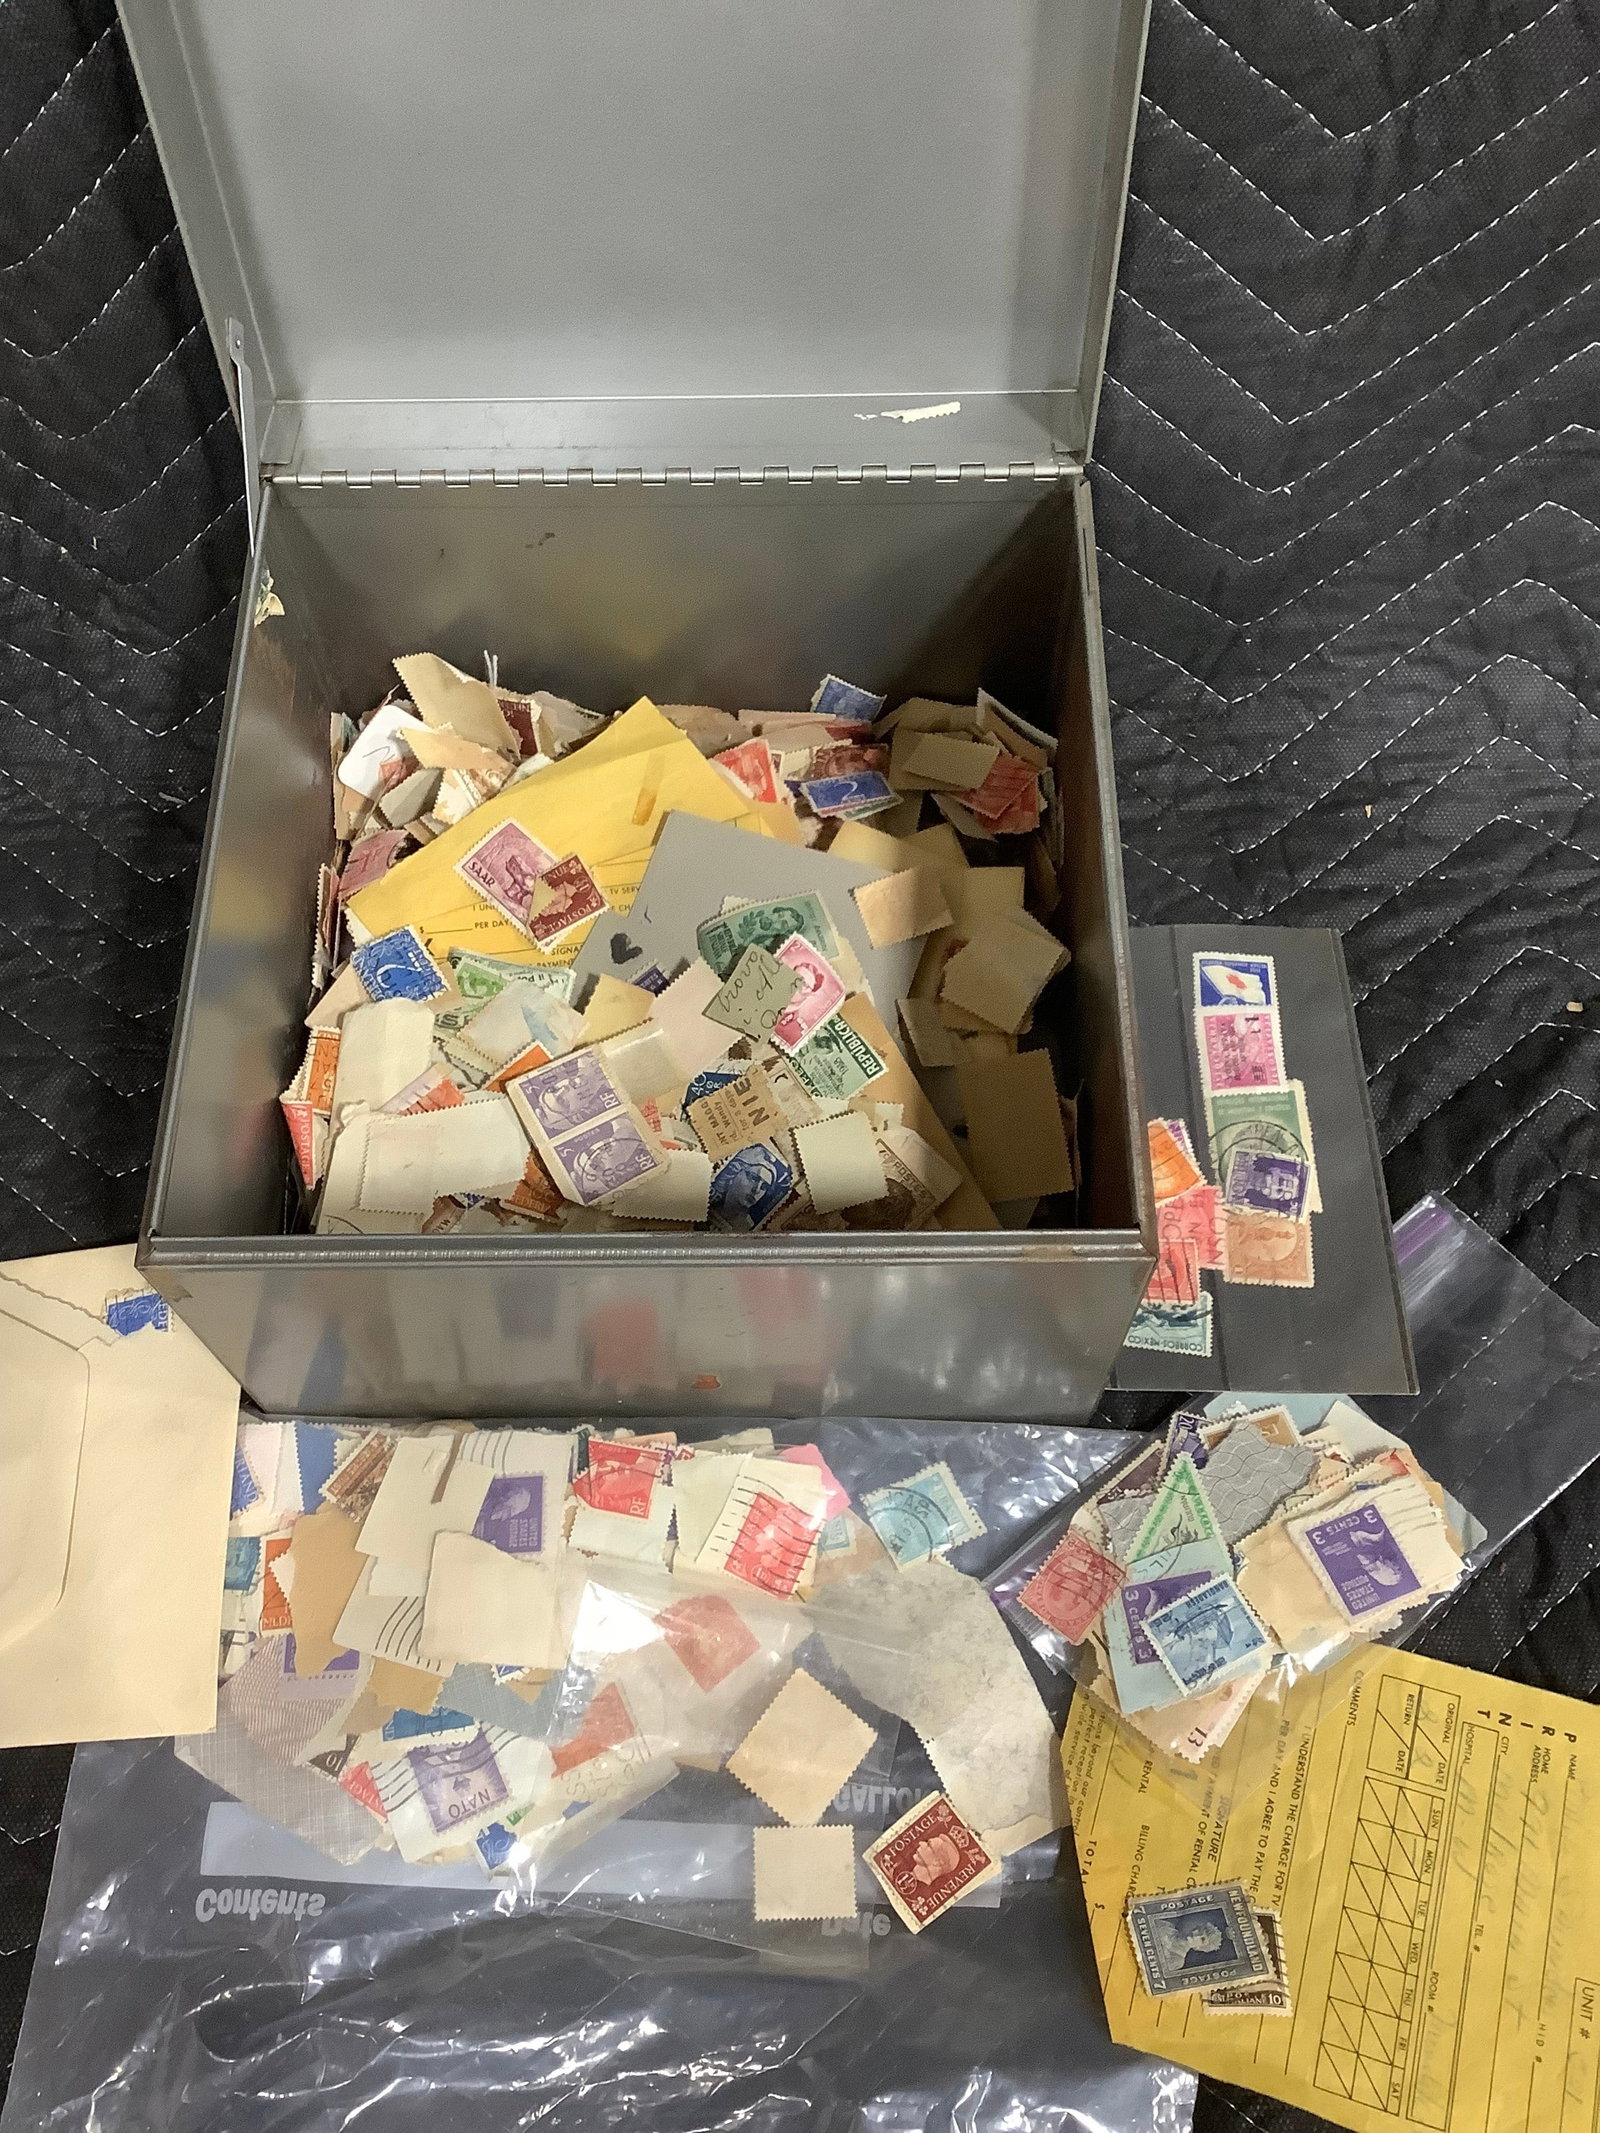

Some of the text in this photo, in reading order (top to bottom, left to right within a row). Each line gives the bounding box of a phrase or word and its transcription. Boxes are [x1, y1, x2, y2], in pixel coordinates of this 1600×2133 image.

[469, 861, 496, 889] SAAR
[475, 921, 490, 930] PER
[492, 919, 510, 928] DAY
[600, 1085, 619, 1109] RF
[300, 1118, 310, 1172] POSTAGE
[635, 1154, 655, 1171] RF
[630, 1496, 647, 1516] RF
[519, 1518, 529, 1547] STATES
[528, 1518, 538, 1547] UNITED
[1312, 1509, 1378, 1545] 3 CENTS 3
[1186, 1580, 1230, 1609] BANGLADESH
[1346, 1583, 1375, 1601] STATES
[1351, 1593, 1380, 1610] UNITED
[1125, 1589, 1153, 1661] 3 CENTS 3
[1346, 1670, 1364, 1727] COMMENTS
[1187, 1726, 1208, 1748] 13
[1281, 1719, 1291, 1738] PER
[1395, 1693, 1415, 1773] RETURN DATE
[1435, 1702, 1456, 1785] ORIGINAL DATE
[1463, 1724, 1475, 1765] HOSPITAL
[1500, 1735, 1511, 1756] CITY
[1073, 1744, 1088, 1794] reception
[1087, 1743, 1102, 1780] beyond
[1291, 1732, 1312, 1801] UNDERSTAND
[1529, 1744, 1540, 1784] ADDRESS
[1541, 1746, 1552, 1775] HOME
[1567, 1753, 1578, 1781] NAME
[1138, 1759, 1154, 1794] RENTAL
[1269, 1766, 1281, 1788] AND
[448, 1788, 492, 1819] NATO
[1261, 1797, 1275, 1832] AGREE
[1286, 1803, 1298, 1822] THE
[889, 1814, 936, 1857] POSTAGE
[1258, 1834, 1269, 1850] TO
[1278, 1825, 1294, 1868] CHARGE
[1126, 1824, 1151, 1898] BILLING CHARG
[1189, 1838, 1205, 1873] RENTAL
[1254, 1852, 1266, 1872] PAY
[1423, 1848, 1434, 1875] MON
[927, 1865, 976, 1909] REVENUE
[1249, 1875, 1261, 1893] THE
[1274, 1871, 1286, 1891] FOR
[1161, 1894, 1216, 1911] POSTAGE
[1271, 1893, 1282, 1907] TV
[1228, 1889, 1264, 1972] NEWFOUNDLAND
[1134, 1905, 1167, 1990] 7 SEVEN CENTS 7
[1181, 1969, 1237, 1985] POSTAGE
[1427, 1971, 1440, 2001] ROOM
[1268, 1993, 1281, 2005] 10
[1580, 1986, 1596, 2023] UNIT
